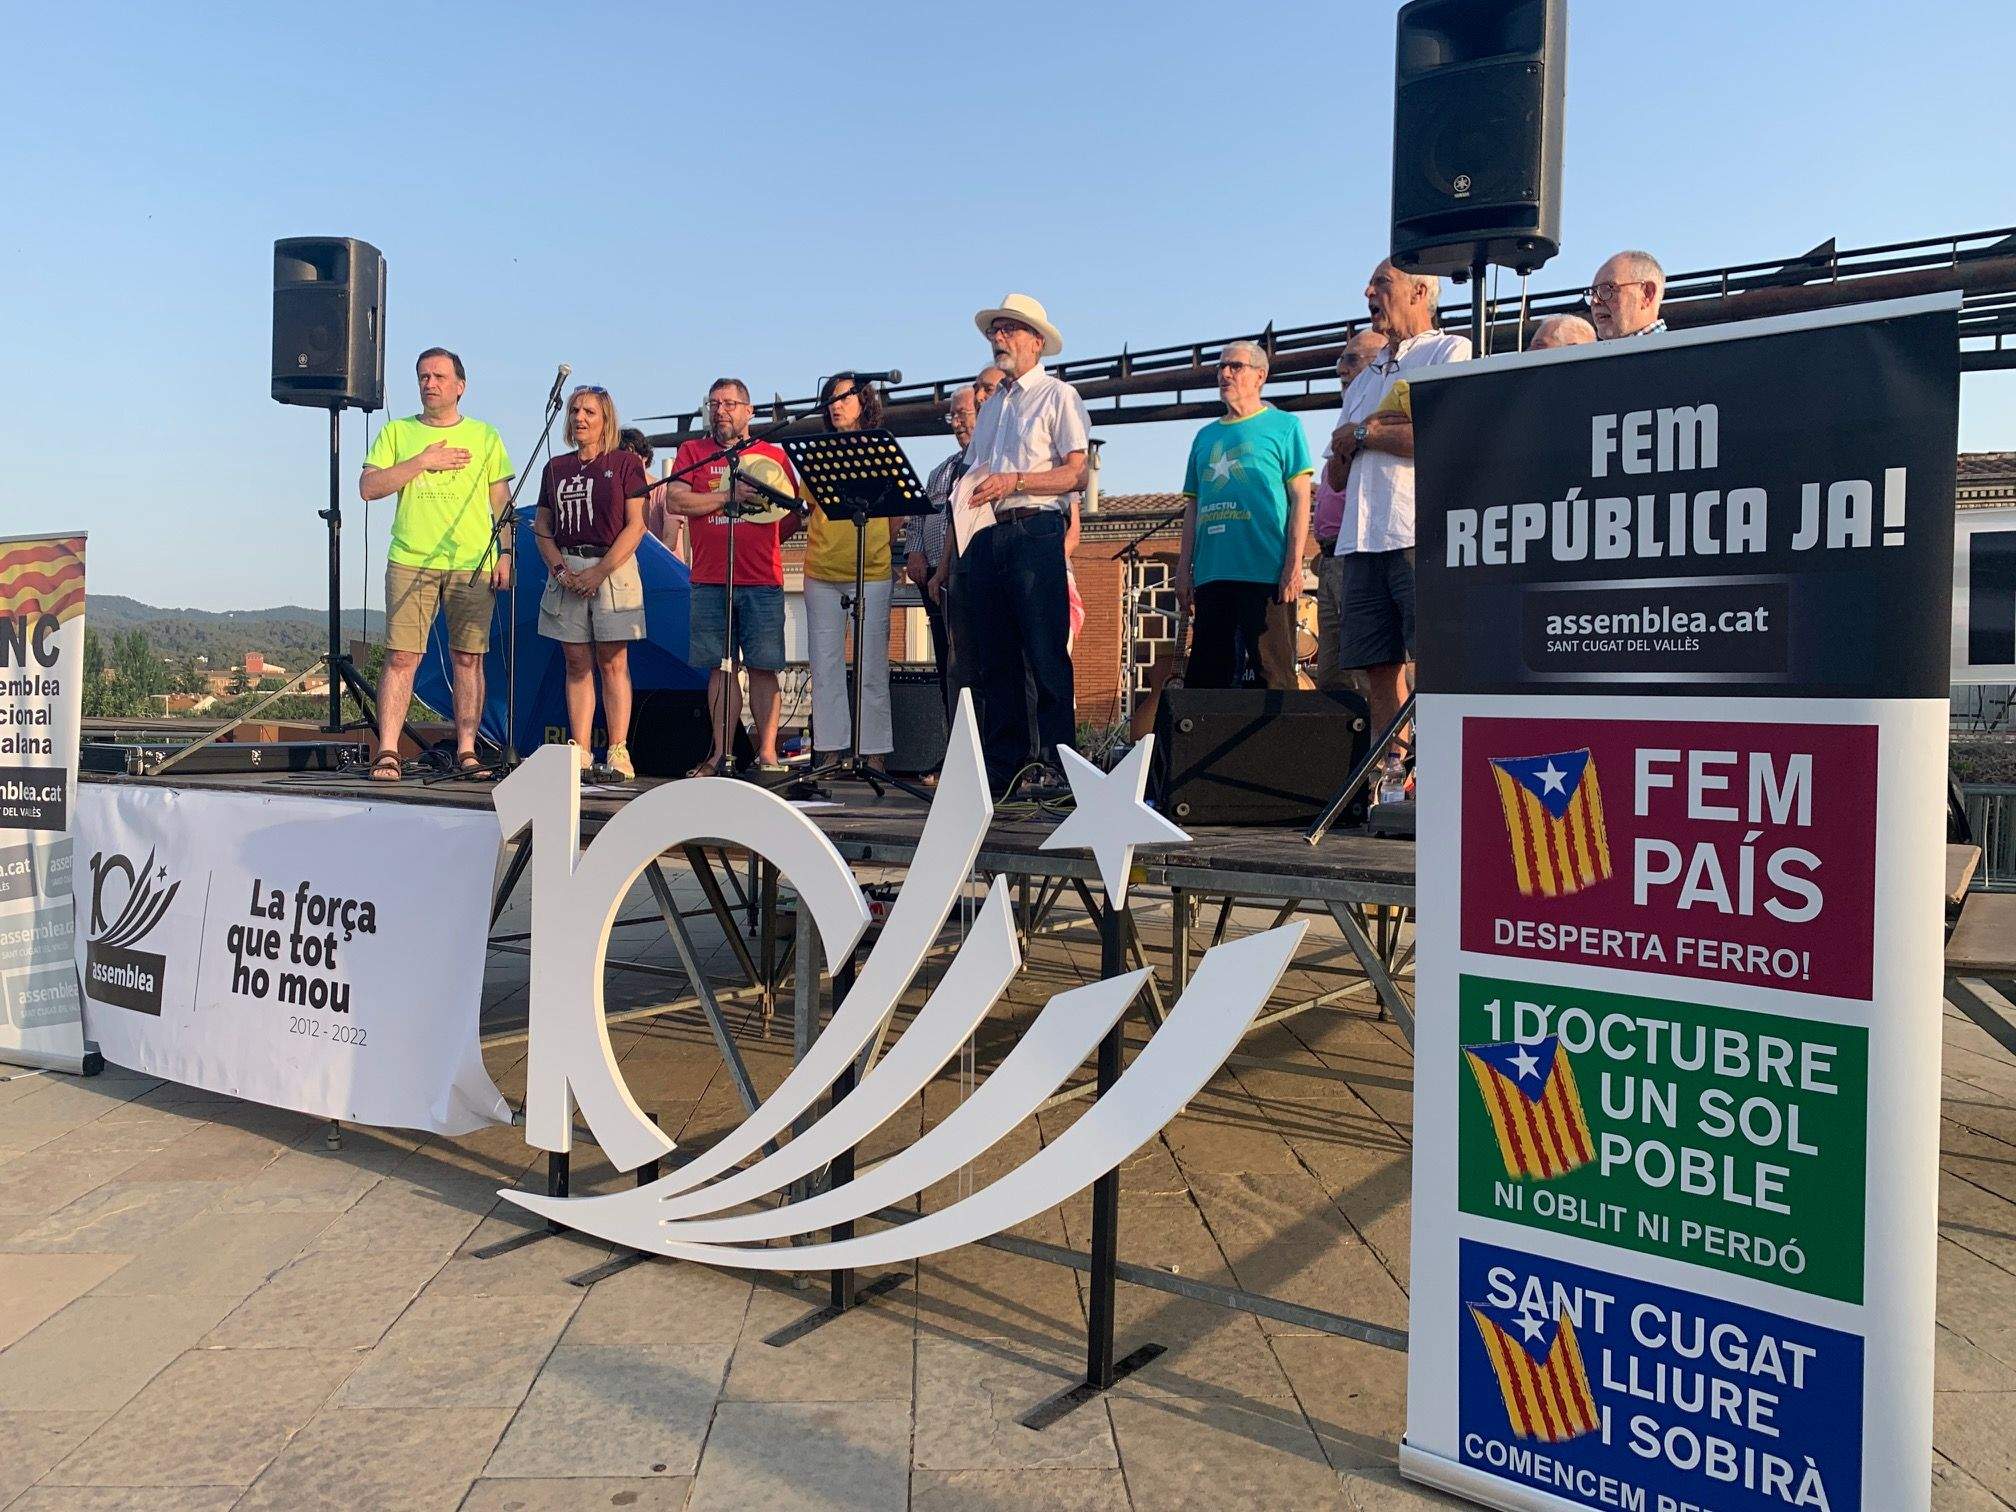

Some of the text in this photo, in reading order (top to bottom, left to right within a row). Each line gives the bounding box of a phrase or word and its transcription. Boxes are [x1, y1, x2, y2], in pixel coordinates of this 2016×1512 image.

[1446, 467, 1907, 567] REPÚBLICA JA!
[1546, 605, 1769, 635] assemblea.cat
[1547, 636, 1699, 652] SANT CUGAT DEL VALLÈS
[3, 807, 19, 817] DEL
[1634, 748, 1813, 827] FEM
[250, 878, 377, 942] La força
[1633, 830, 1824, 924] PAÍS
[92, 960, 154, 993] assemblea
[226, 923, 338, 970] que tot
[231, 953, 351, 1014] ho mou
[1494, 918, 1810, 981] DESPERTA FERRO!
[289, 1016, 320, 1038] 2012
[332, 1025, 368, 1047] 2022
[1601, 1072, 1819, 1156] UN SOL
[1601, 1132, 1791, 1216] POBLE
[1494, 1181, 1806, 1275] NI OBLIT NI PERDÓ
[1486, 1267, 1817, 1389] SANT CUGAT
[1602, 1349, 1780, 1438] LLIURE
[1464, 1432, 1646, 1512] COMENCEM
[1602, 1405, 1831, 1512] I SOBIRÀ
